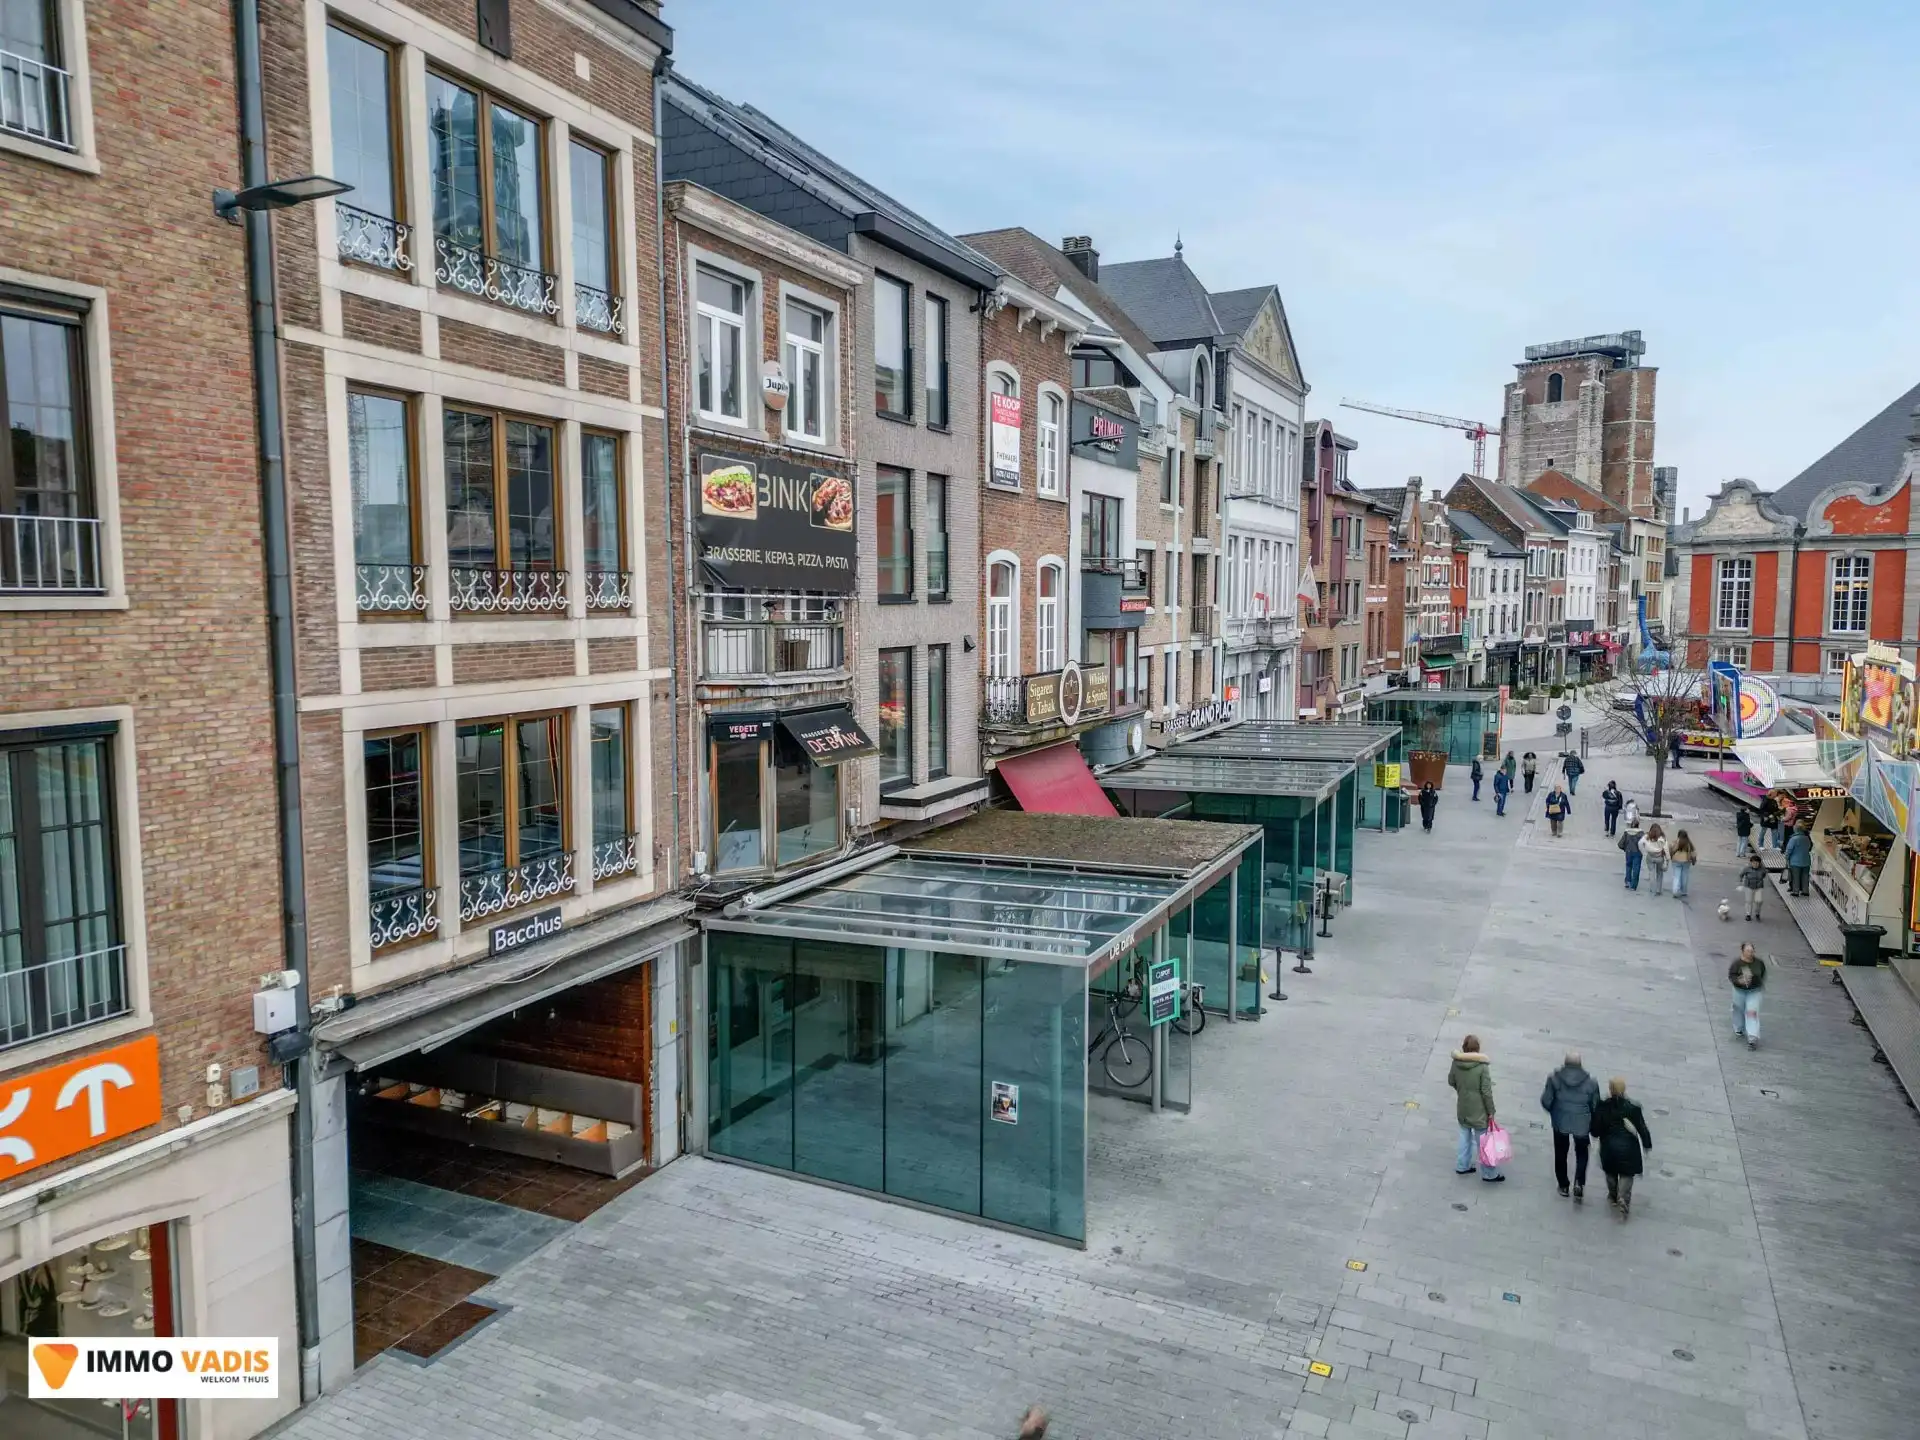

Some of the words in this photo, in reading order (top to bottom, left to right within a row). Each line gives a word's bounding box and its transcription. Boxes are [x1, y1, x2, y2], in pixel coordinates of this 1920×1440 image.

[758, 473, 809, 513] BINK
[706, 545, 763, 565] BRASSERIE,
[797, 553, 824, 569] PIZZA,
[825, 555, 849, 570] PASTA
[1029, 684, 1054, 700] Sigaren
[1037, 699, 1056, 715] Tabak
[1190, 705, 1215, 728] GRAND
[729, 724, 758, 733] VEDETT
[807, 739, 831, 753] DE
[494, 915, 562, 951] Bacchus
